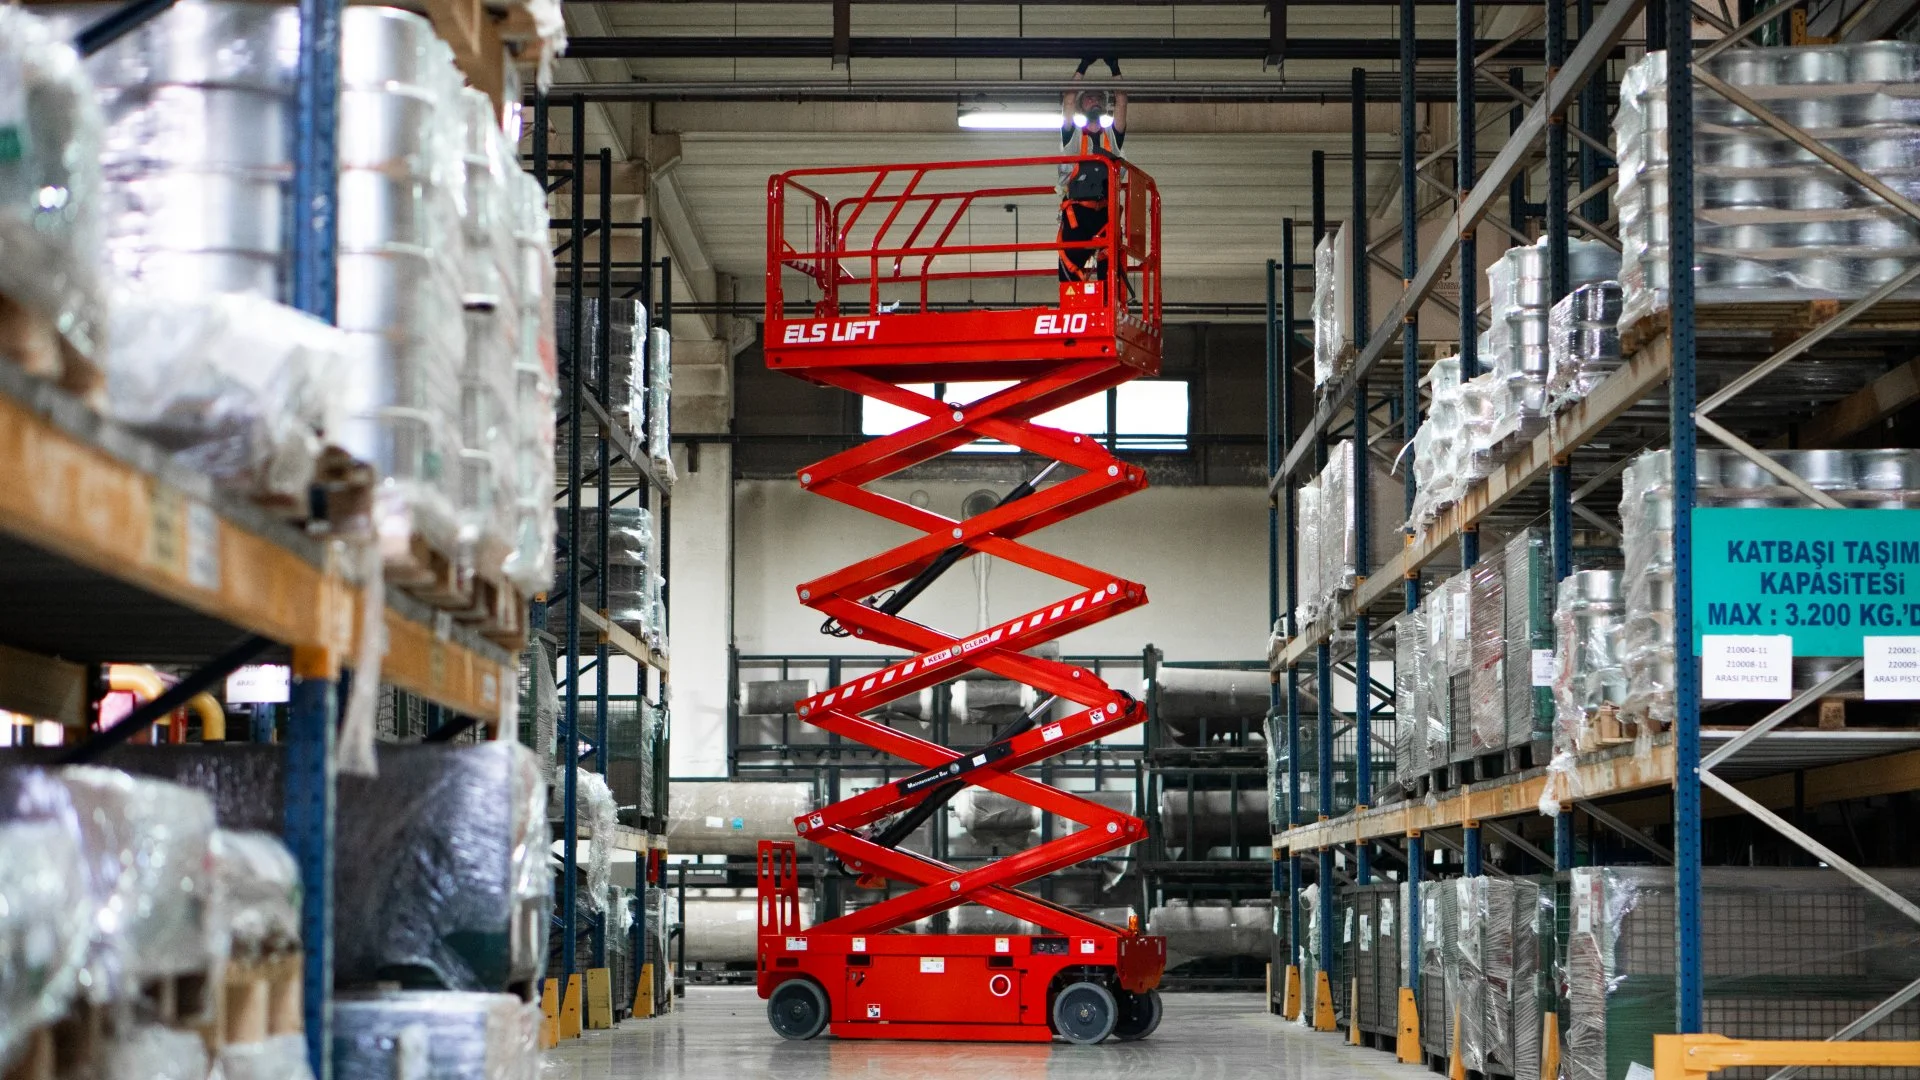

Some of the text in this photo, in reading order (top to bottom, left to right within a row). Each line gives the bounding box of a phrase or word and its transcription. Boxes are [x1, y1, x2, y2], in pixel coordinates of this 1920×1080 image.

[783, 320, 881, 344] ELS LIFT
[1034, 313, 1088, 335] EL10
[1727, 540, 1920, 569] KATBAŞI TAŞIM
[1708, 602, 1762, 626] MAX
[1784, 602, 1851, 627] 3.200
[928, 636, 989, 663] KEEP CLEAR
[1726, 646, 1768, 654] 210004-11
[1715, 674, 1778, 683] ARASI PLEYTLER
[1873, 675, 1898, 683] ARASI
[907, 773, 939, 789] Maintenance
